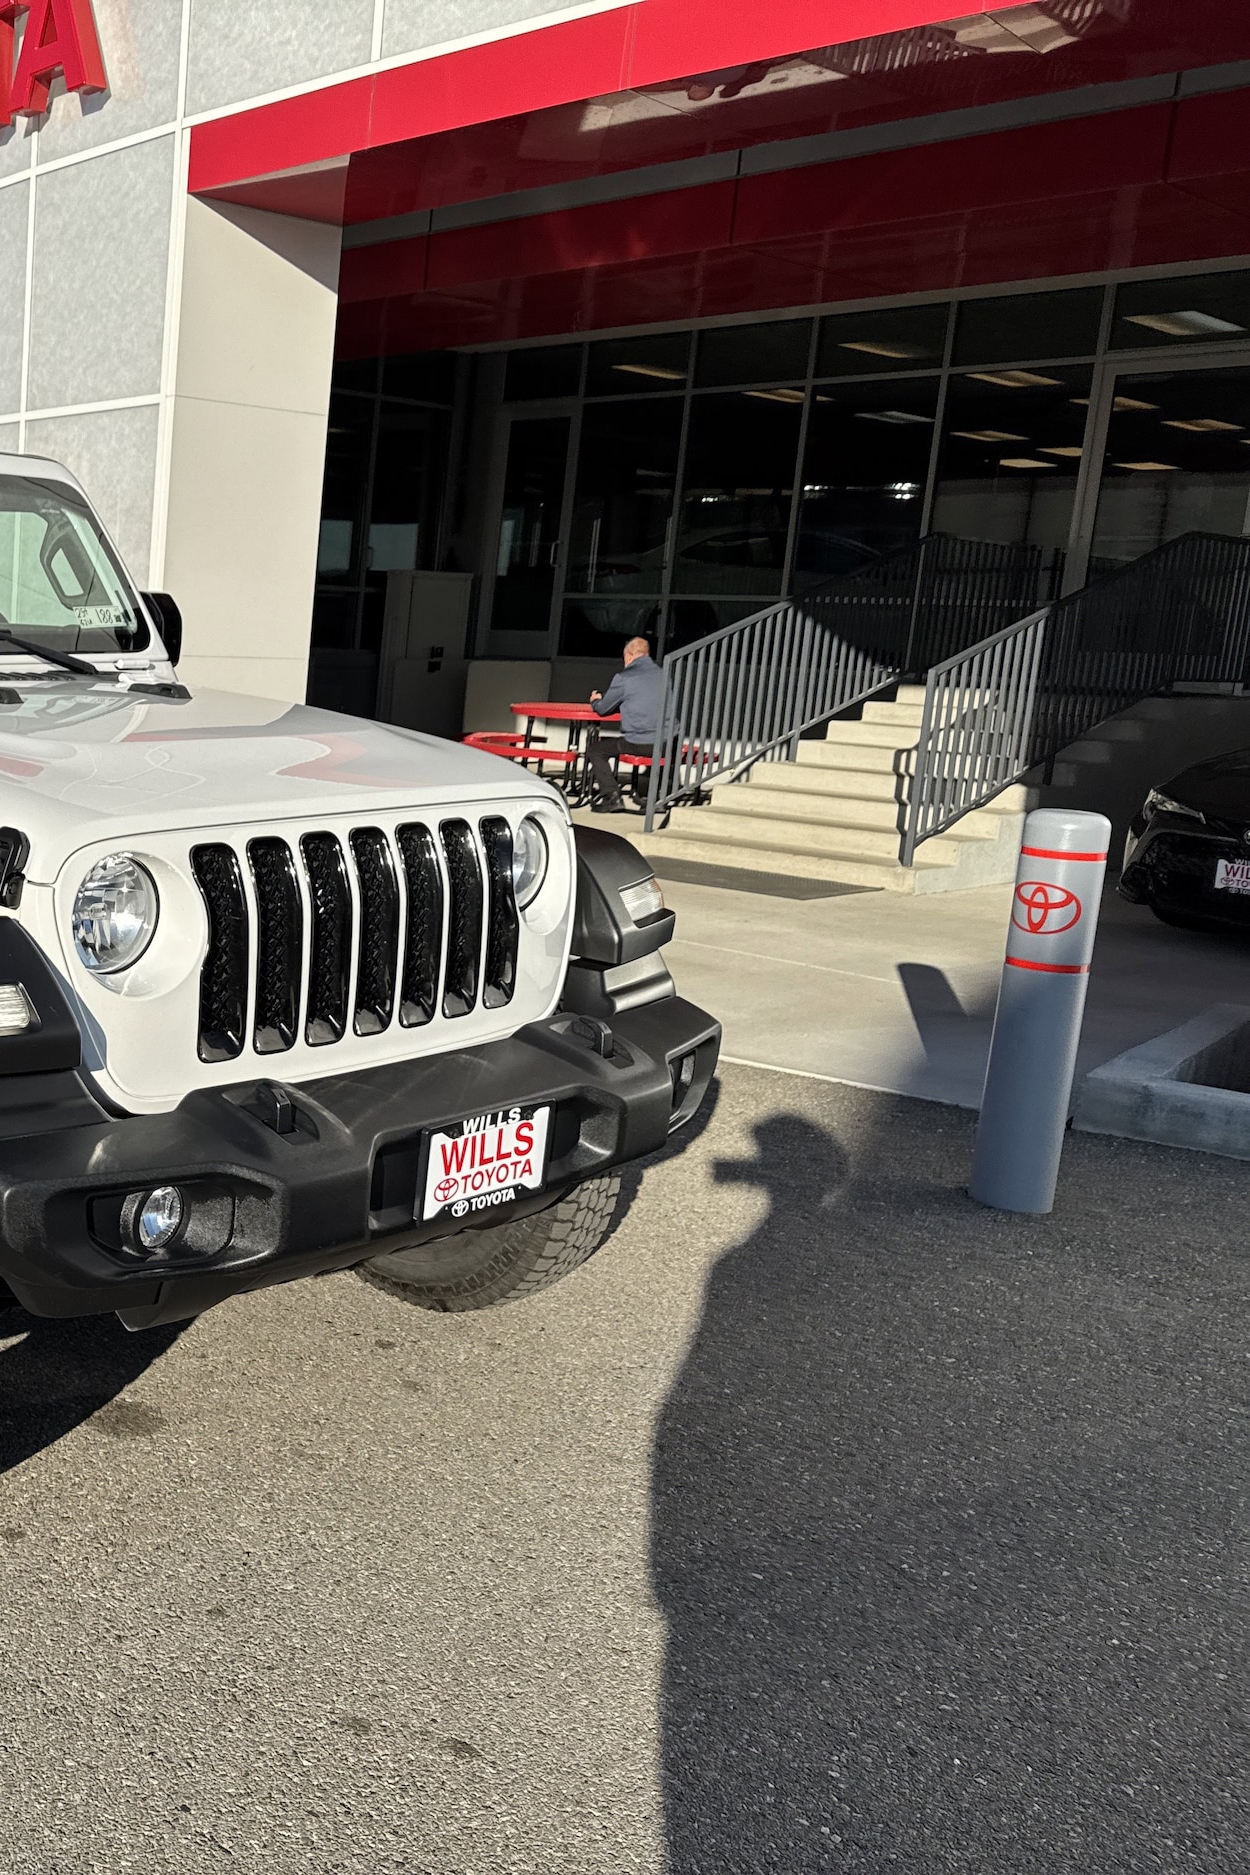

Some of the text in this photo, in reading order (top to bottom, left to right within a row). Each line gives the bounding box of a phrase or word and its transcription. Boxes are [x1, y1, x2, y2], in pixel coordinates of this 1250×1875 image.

[1225, 864, 1250, 880] WIL
[462, 1107, 522, 1136] WILLS
[440, 1121, 534, 1177] WILLS
[461, 1158, 533, 1194] TOYOTA
[471, 1187, 516, 1212] TOYOTA
